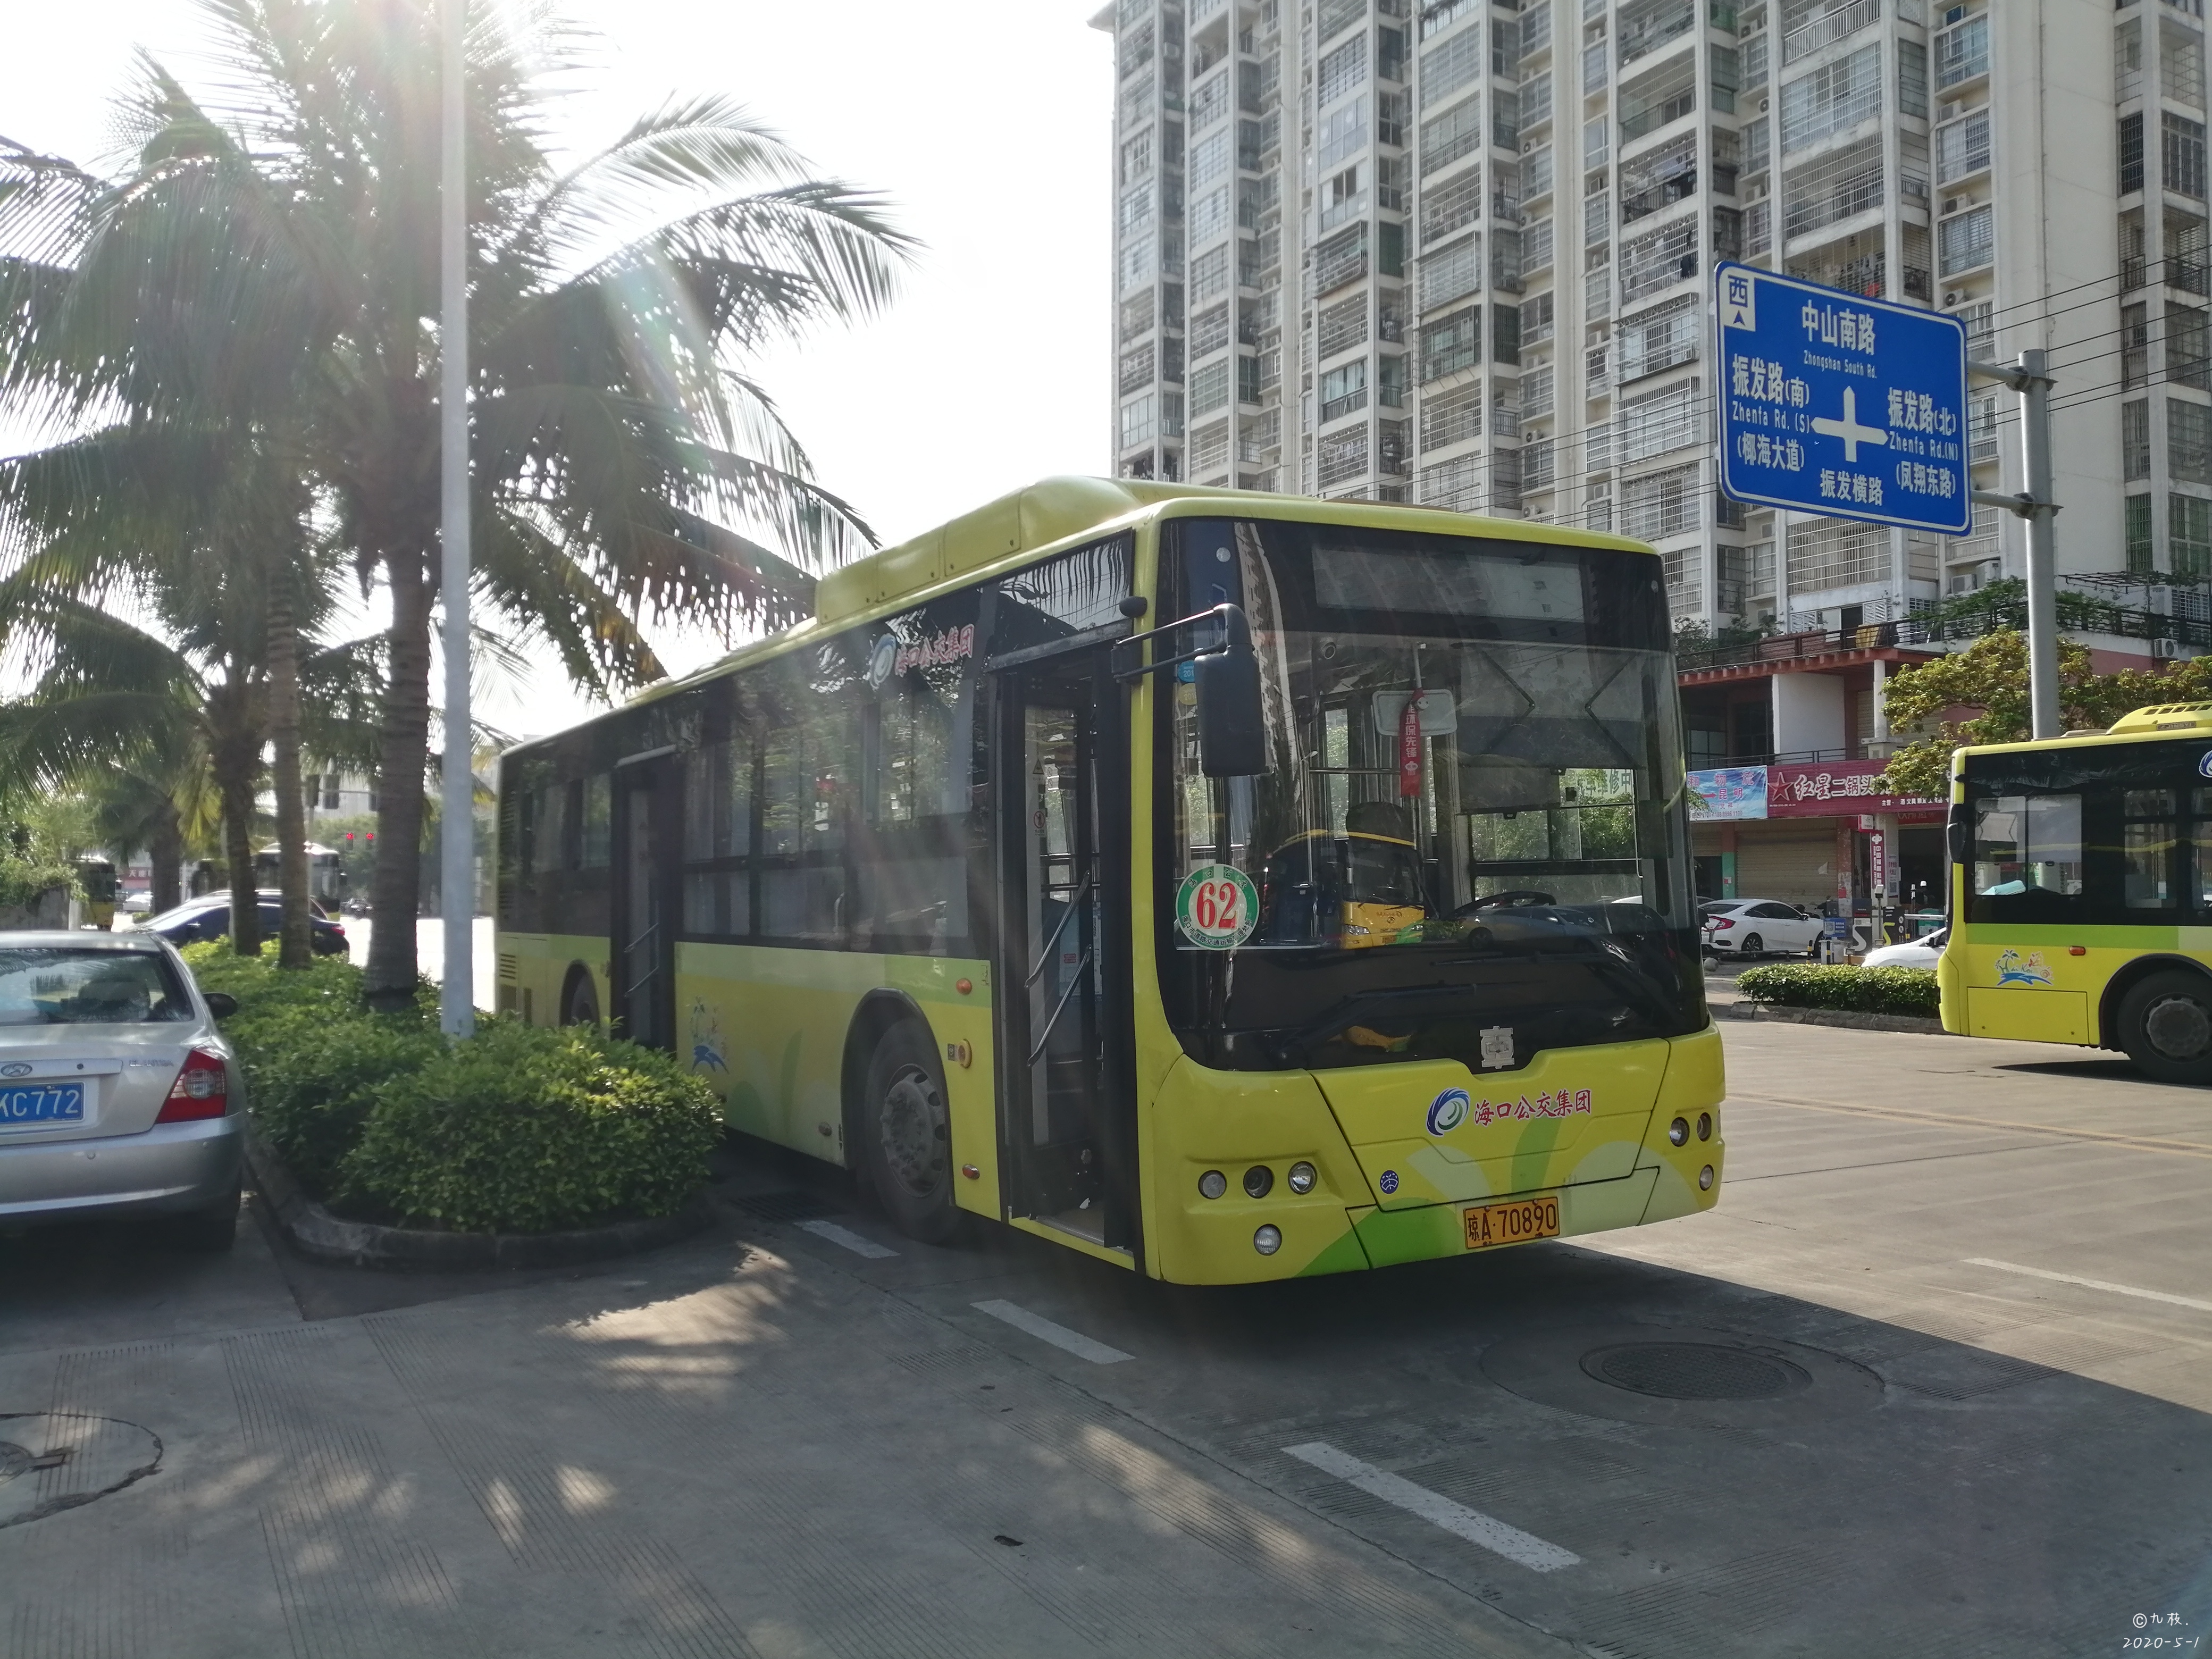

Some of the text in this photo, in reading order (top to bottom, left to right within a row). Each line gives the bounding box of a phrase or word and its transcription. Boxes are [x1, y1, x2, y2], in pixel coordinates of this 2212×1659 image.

[1728, 275, 1749, 307] 西
[1802, 299, 1876, 356] 中山南路
[1732, 353, 1810, 408] 振发路(南)
[1804, 349, 1877, 379] Zhongshan South Rd.
[1732, 401, 1810, 434] Zhenfa Rd. (S)
[1888, 387, 1957, 436] 振发路(北)
[1737, 431, 1804, 472] (椰海大道)
[1889, 431, 1924, 456] Zhenfa
[1820, 468, 1883, 507] 振发横路
[1896, 460, 1956, 499] (凤翔东路)
[1719, 787, 1744, 800] 昆明
[1794, 773, 1893, 801] 红星二锅头
[1188, 869, 1248, 890] 海口公交
[1196, 882, 1237, 929] 62
[1474, 1088, 1592, 1127] 海口公交集团
[1468, 1203, 1557, 1242] 琼A·70890
